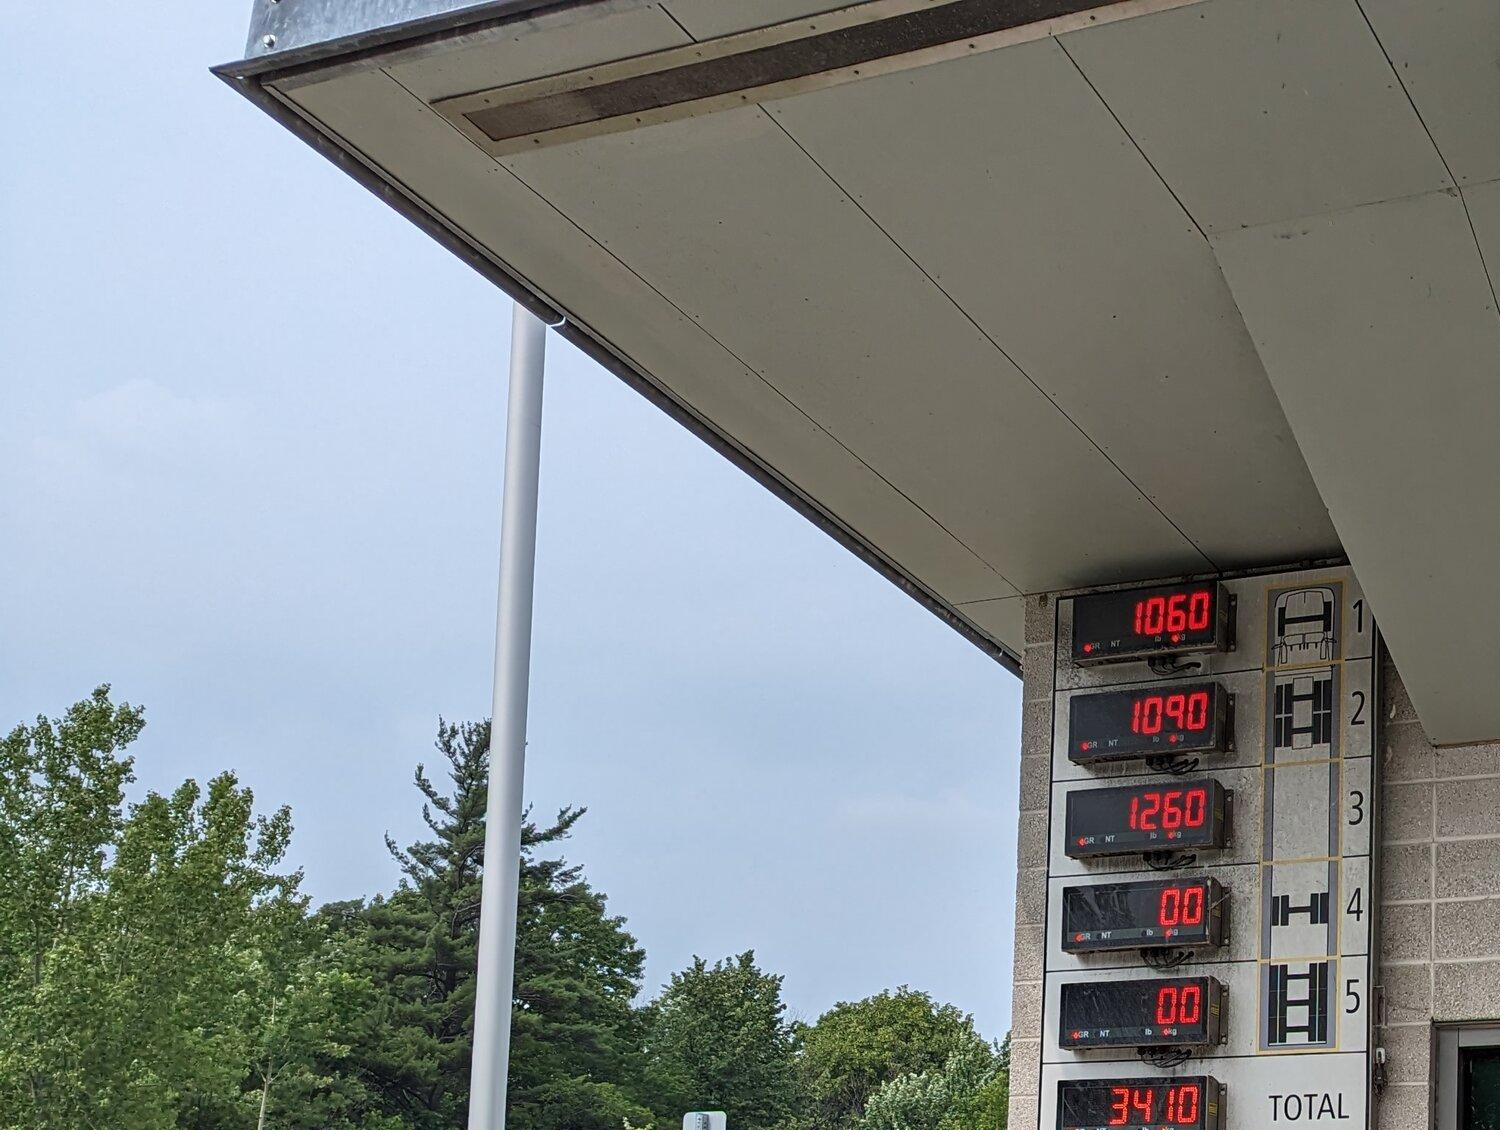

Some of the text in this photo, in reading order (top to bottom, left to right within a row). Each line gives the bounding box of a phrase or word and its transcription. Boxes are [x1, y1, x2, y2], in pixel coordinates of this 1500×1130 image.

[1134, 592, 1209, 635] 1060
[1352, 599, 1363, 633] 1
[1131, 692, 1208, 734] 1090
[1350, 691, 1366, 726] 2
[1108, 739, 1119, 747] NT
[1129, 789, 1207, 830] 1260
[1348, 790, 1364, 826] 3
[1105, 835, 1116, 843] NT
[1150, 832, 1157, 840] lb
[1159, 886, 1203, 926] 00
[1346, 887, 1364, 922] 4
[1101, 931, 1112, 939] NT
[1156, 986, 1201, 1025] 00
[1345, 978, 1361, 1014] 5
[1079, 1030, 1090, 1038] GR
[1099, 1029, 1111, 1037] NT
[1144, 1028, 1153, 1036] lb
[1109, 1085, 1199, 1126] 3410
[1268, 1092, 1350, 1122] TOTAL
